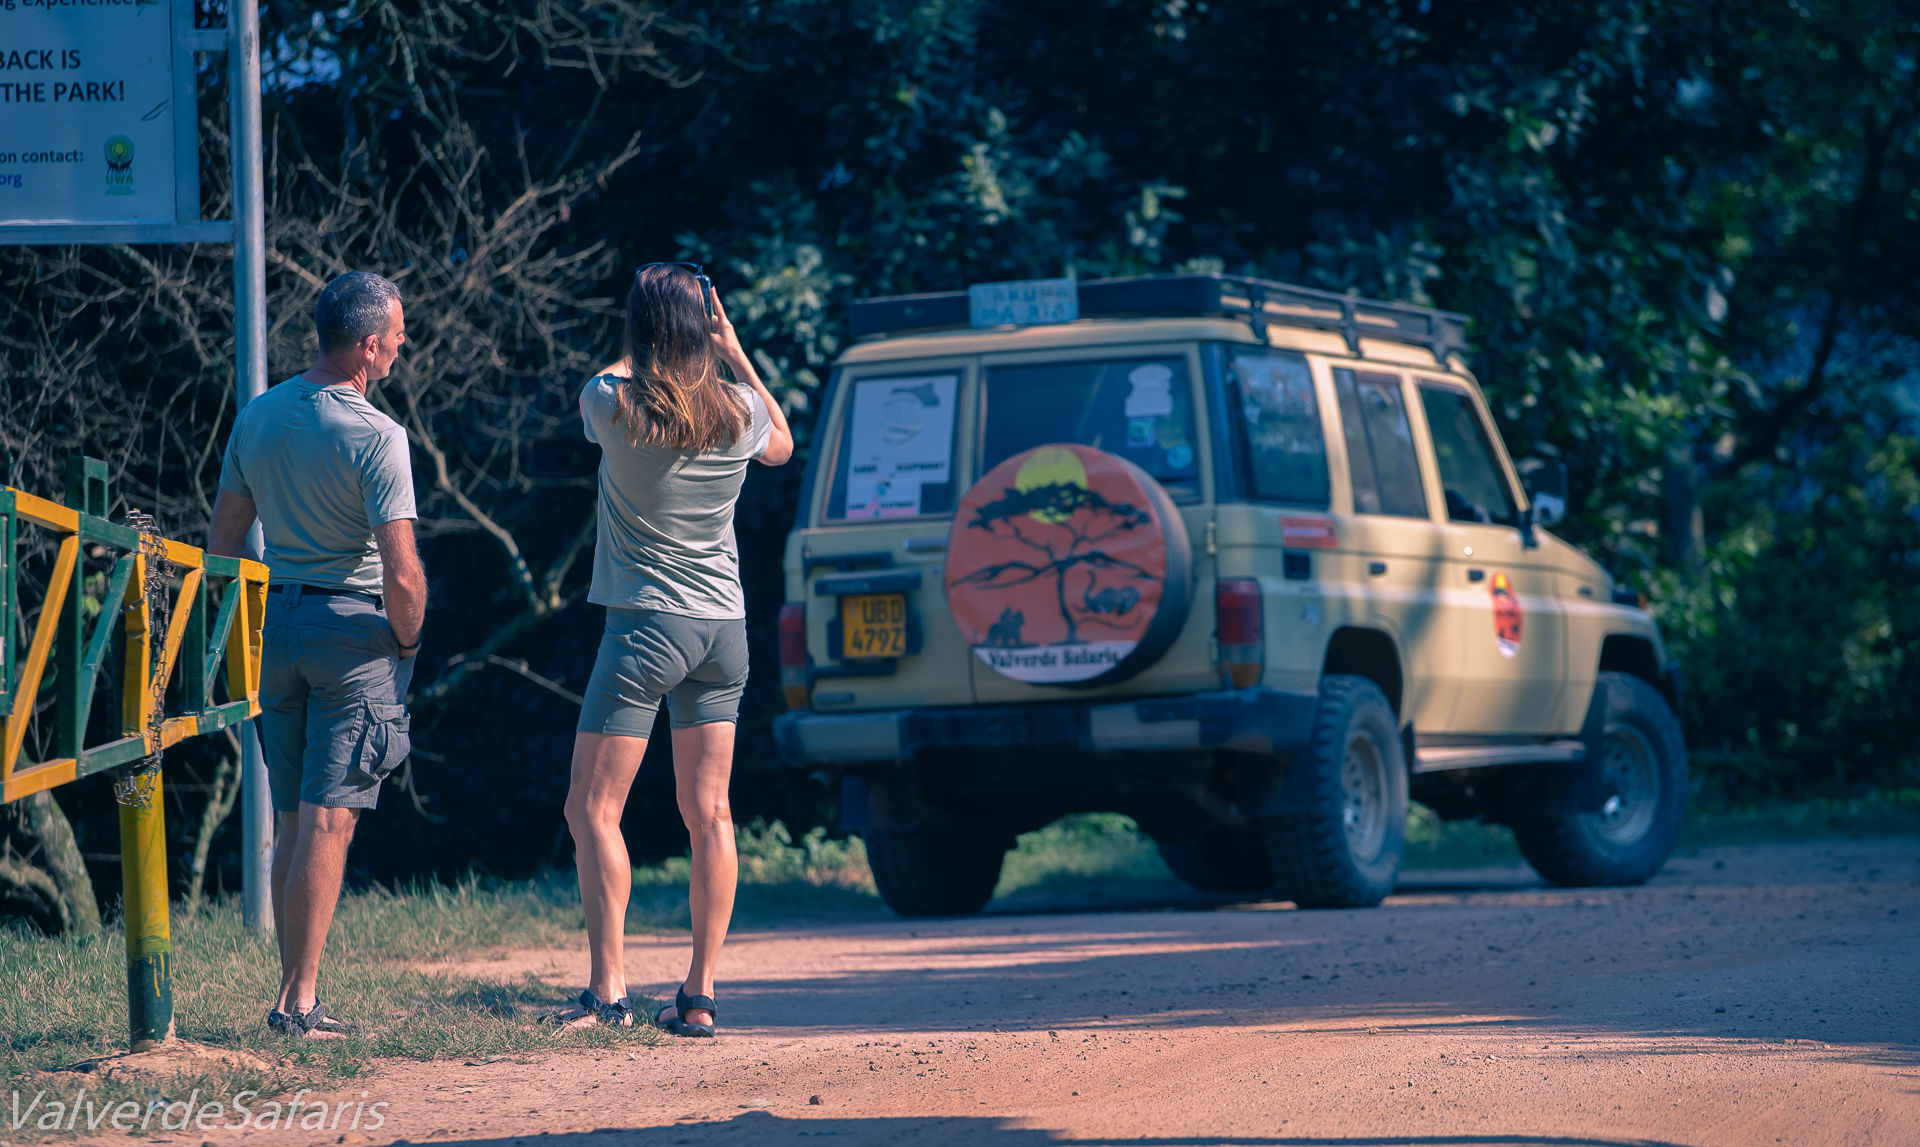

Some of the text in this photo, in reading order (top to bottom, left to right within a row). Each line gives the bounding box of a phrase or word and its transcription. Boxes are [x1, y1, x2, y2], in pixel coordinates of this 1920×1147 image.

[0, 0, 16, 11] g
[61, 49, 81, 70] IS
[0, 80, 125, 103] THE PARK!
[21, 149, 84, 163] contact:
[106, 173, 134, 185] UWA
[863, 599, 904, 624] UBD
[852, 626, 904, 652] 479Z
[989, 649, 1057, 667] Valverde
